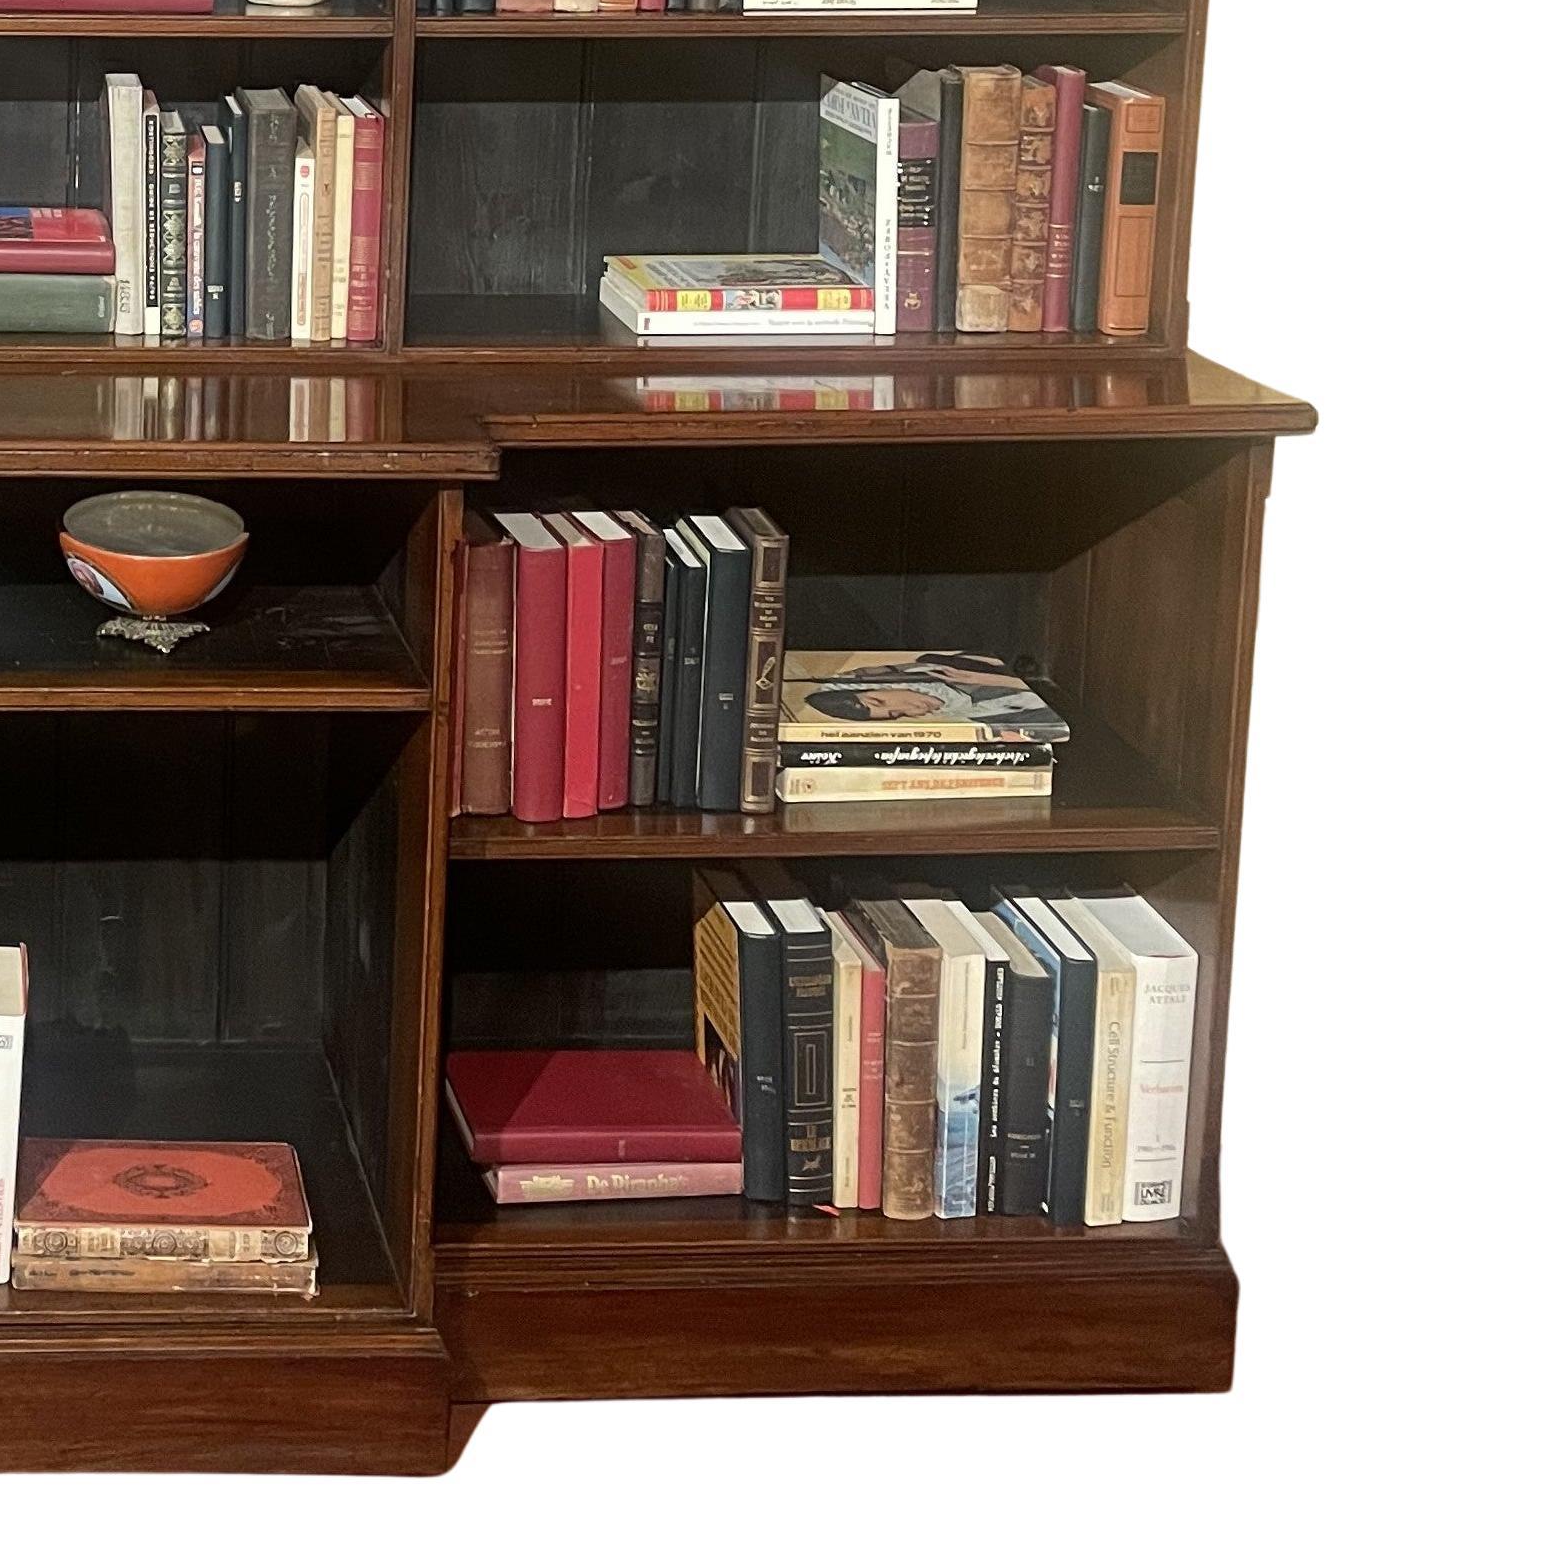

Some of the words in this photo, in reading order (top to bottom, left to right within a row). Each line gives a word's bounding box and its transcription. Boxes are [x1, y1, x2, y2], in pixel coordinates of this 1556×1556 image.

[913, 730, 942, 738] 1970
[1144, 983, 1190, 994] JACQUES
[1149, 993, 1186, 1004] ATTALI
[1108, 1020, 1121, 1045] Cell
[1106, 1047, 1121, 1102] Structure
[1102, 1116, 1118, 1169] Function
[586, 1175, 608, 1189] De
